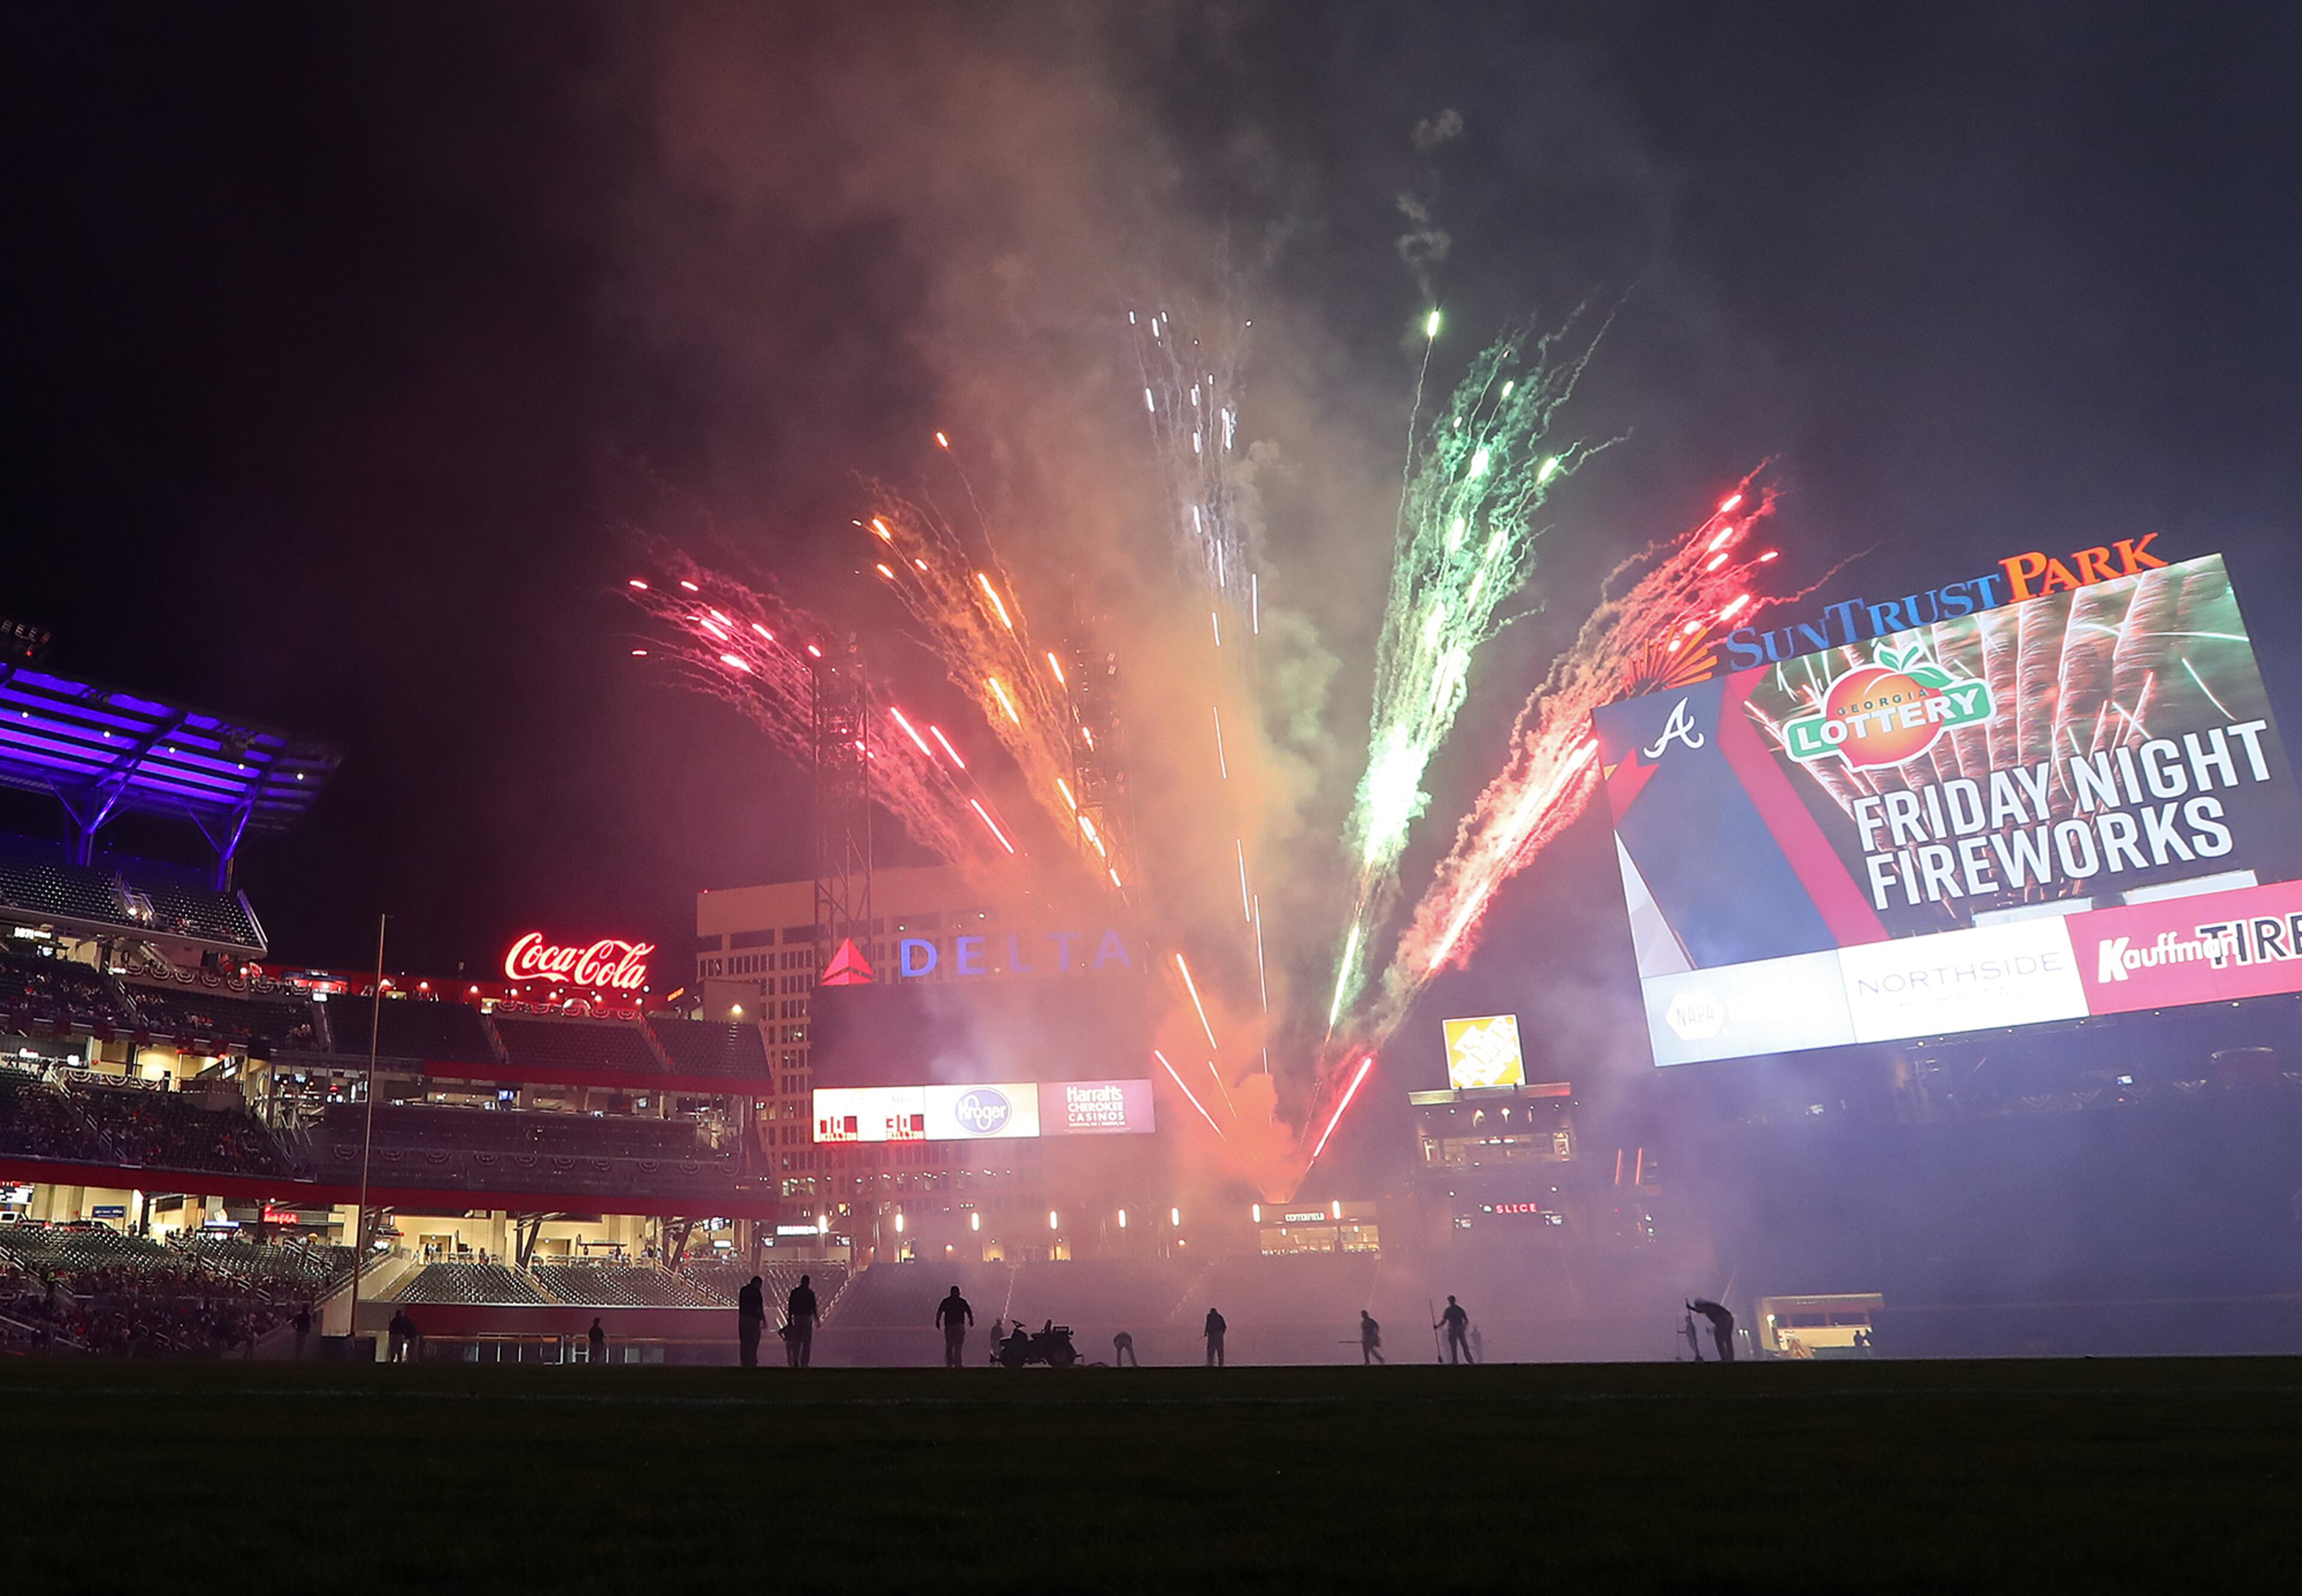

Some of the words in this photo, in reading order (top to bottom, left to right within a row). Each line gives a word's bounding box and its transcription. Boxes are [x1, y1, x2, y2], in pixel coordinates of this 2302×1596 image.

[1999, 532, 2168, 604] PARK
[1796, 687, 1981, 752] LOTTERY
[1837, 689, 1929, 716] GEORGIA
[1852, 762, 2051, 852] FRIDAY
[2070, 719, 2271, 813] NIGHT
[1866, 796, 2234, 910] FIREWORKS
[505, 932, 655, 989] Coca-Cola
[900, 930, 1133, 978] DELTA
[1858, 951, 2064, 995] NORTHSIDE
[2098, 931, 2240, 983] Kauffman
[1676, 1003, 1716, 1027] NAPA
[958, 1094, 1007, 1130] Kroger
[1068, 1102, 1124, 1112] CHEROKEE
[1068, 1112, 1125, 1122] CASINOS
[1496, 1203, 1537, 1214] SLICE
